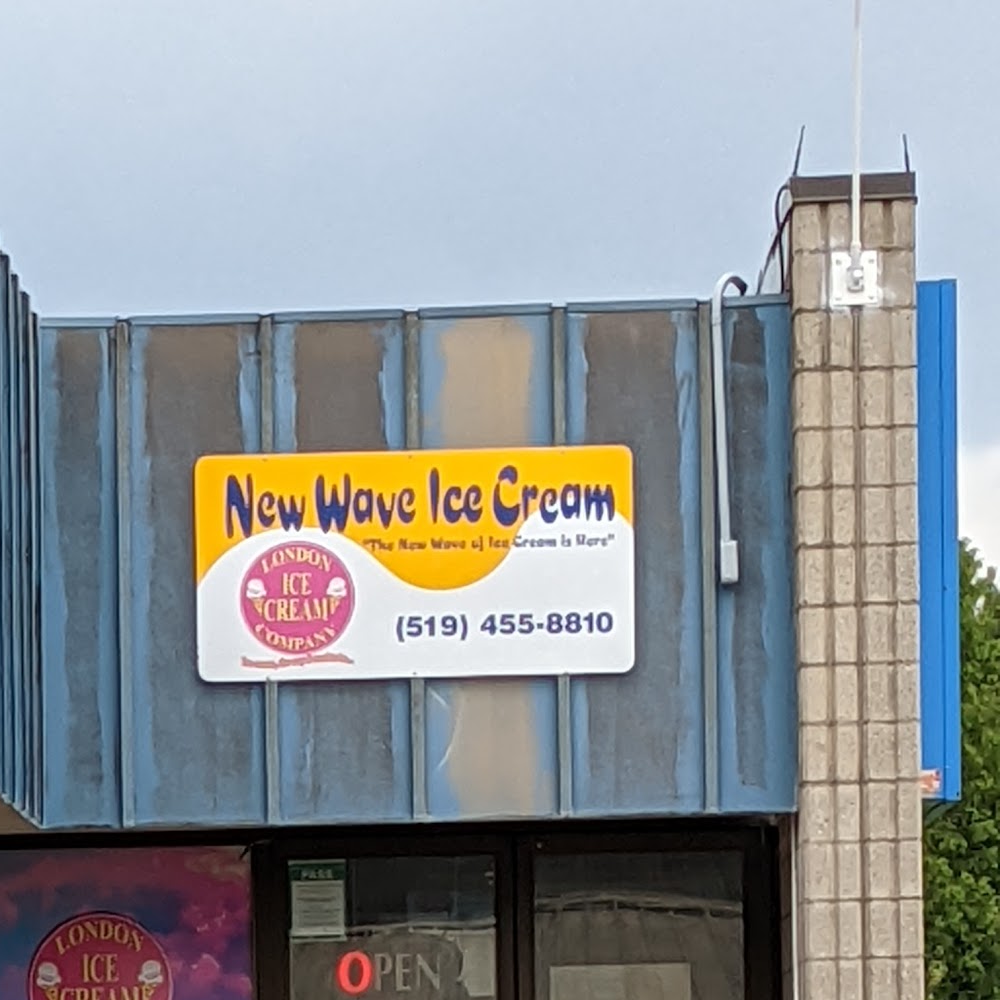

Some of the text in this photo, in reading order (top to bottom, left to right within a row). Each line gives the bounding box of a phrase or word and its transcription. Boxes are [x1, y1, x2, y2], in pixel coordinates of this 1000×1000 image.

[226, 465, 615, 538] New Wave Ice Cream
[399, 539, 427, 551] New
[430, 538, 466, 550] Wave
[472, 536, 483, 551] of
[488, 536, 509, 549] Ice
[512, 535, 557, 547] Cream
[261, 546, 332, 574] LONDON
[282, 572, 312, 595] ICE
[263, 598, 328, 621] CREAM
[255, 624, 336, 651] COMPANY
[395, 611, 614, 642] (519) 455-8810
[55, 919, 144, 955] LONDON
[81, 953, 119, 984] ICE
[337, 951, 441, 994] OPEN
